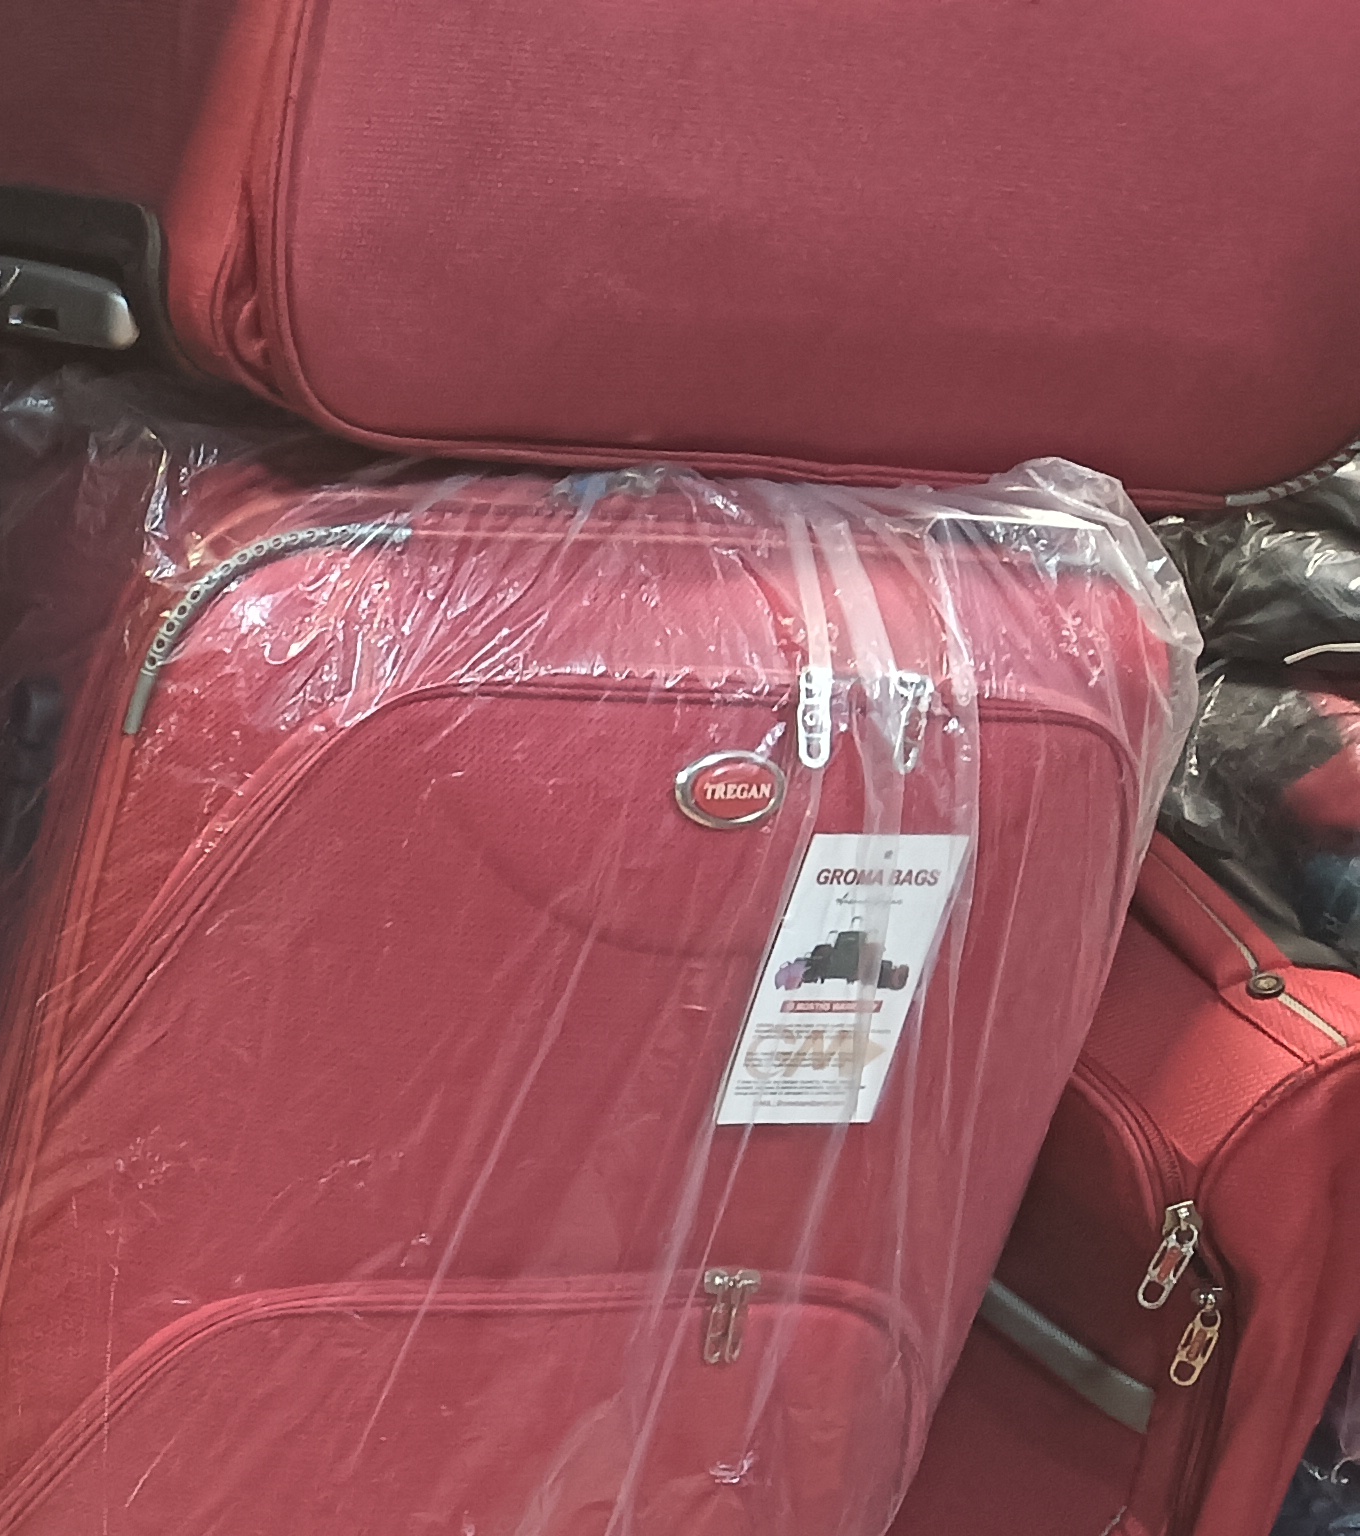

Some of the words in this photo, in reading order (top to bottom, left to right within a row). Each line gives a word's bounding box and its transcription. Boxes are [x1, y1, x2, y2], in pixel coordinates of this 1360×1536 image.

[704, 782, 772, 800] TREGAN
[816, 868, 884, 886] GROMA
[889, 869, 942, 887] BAGS
